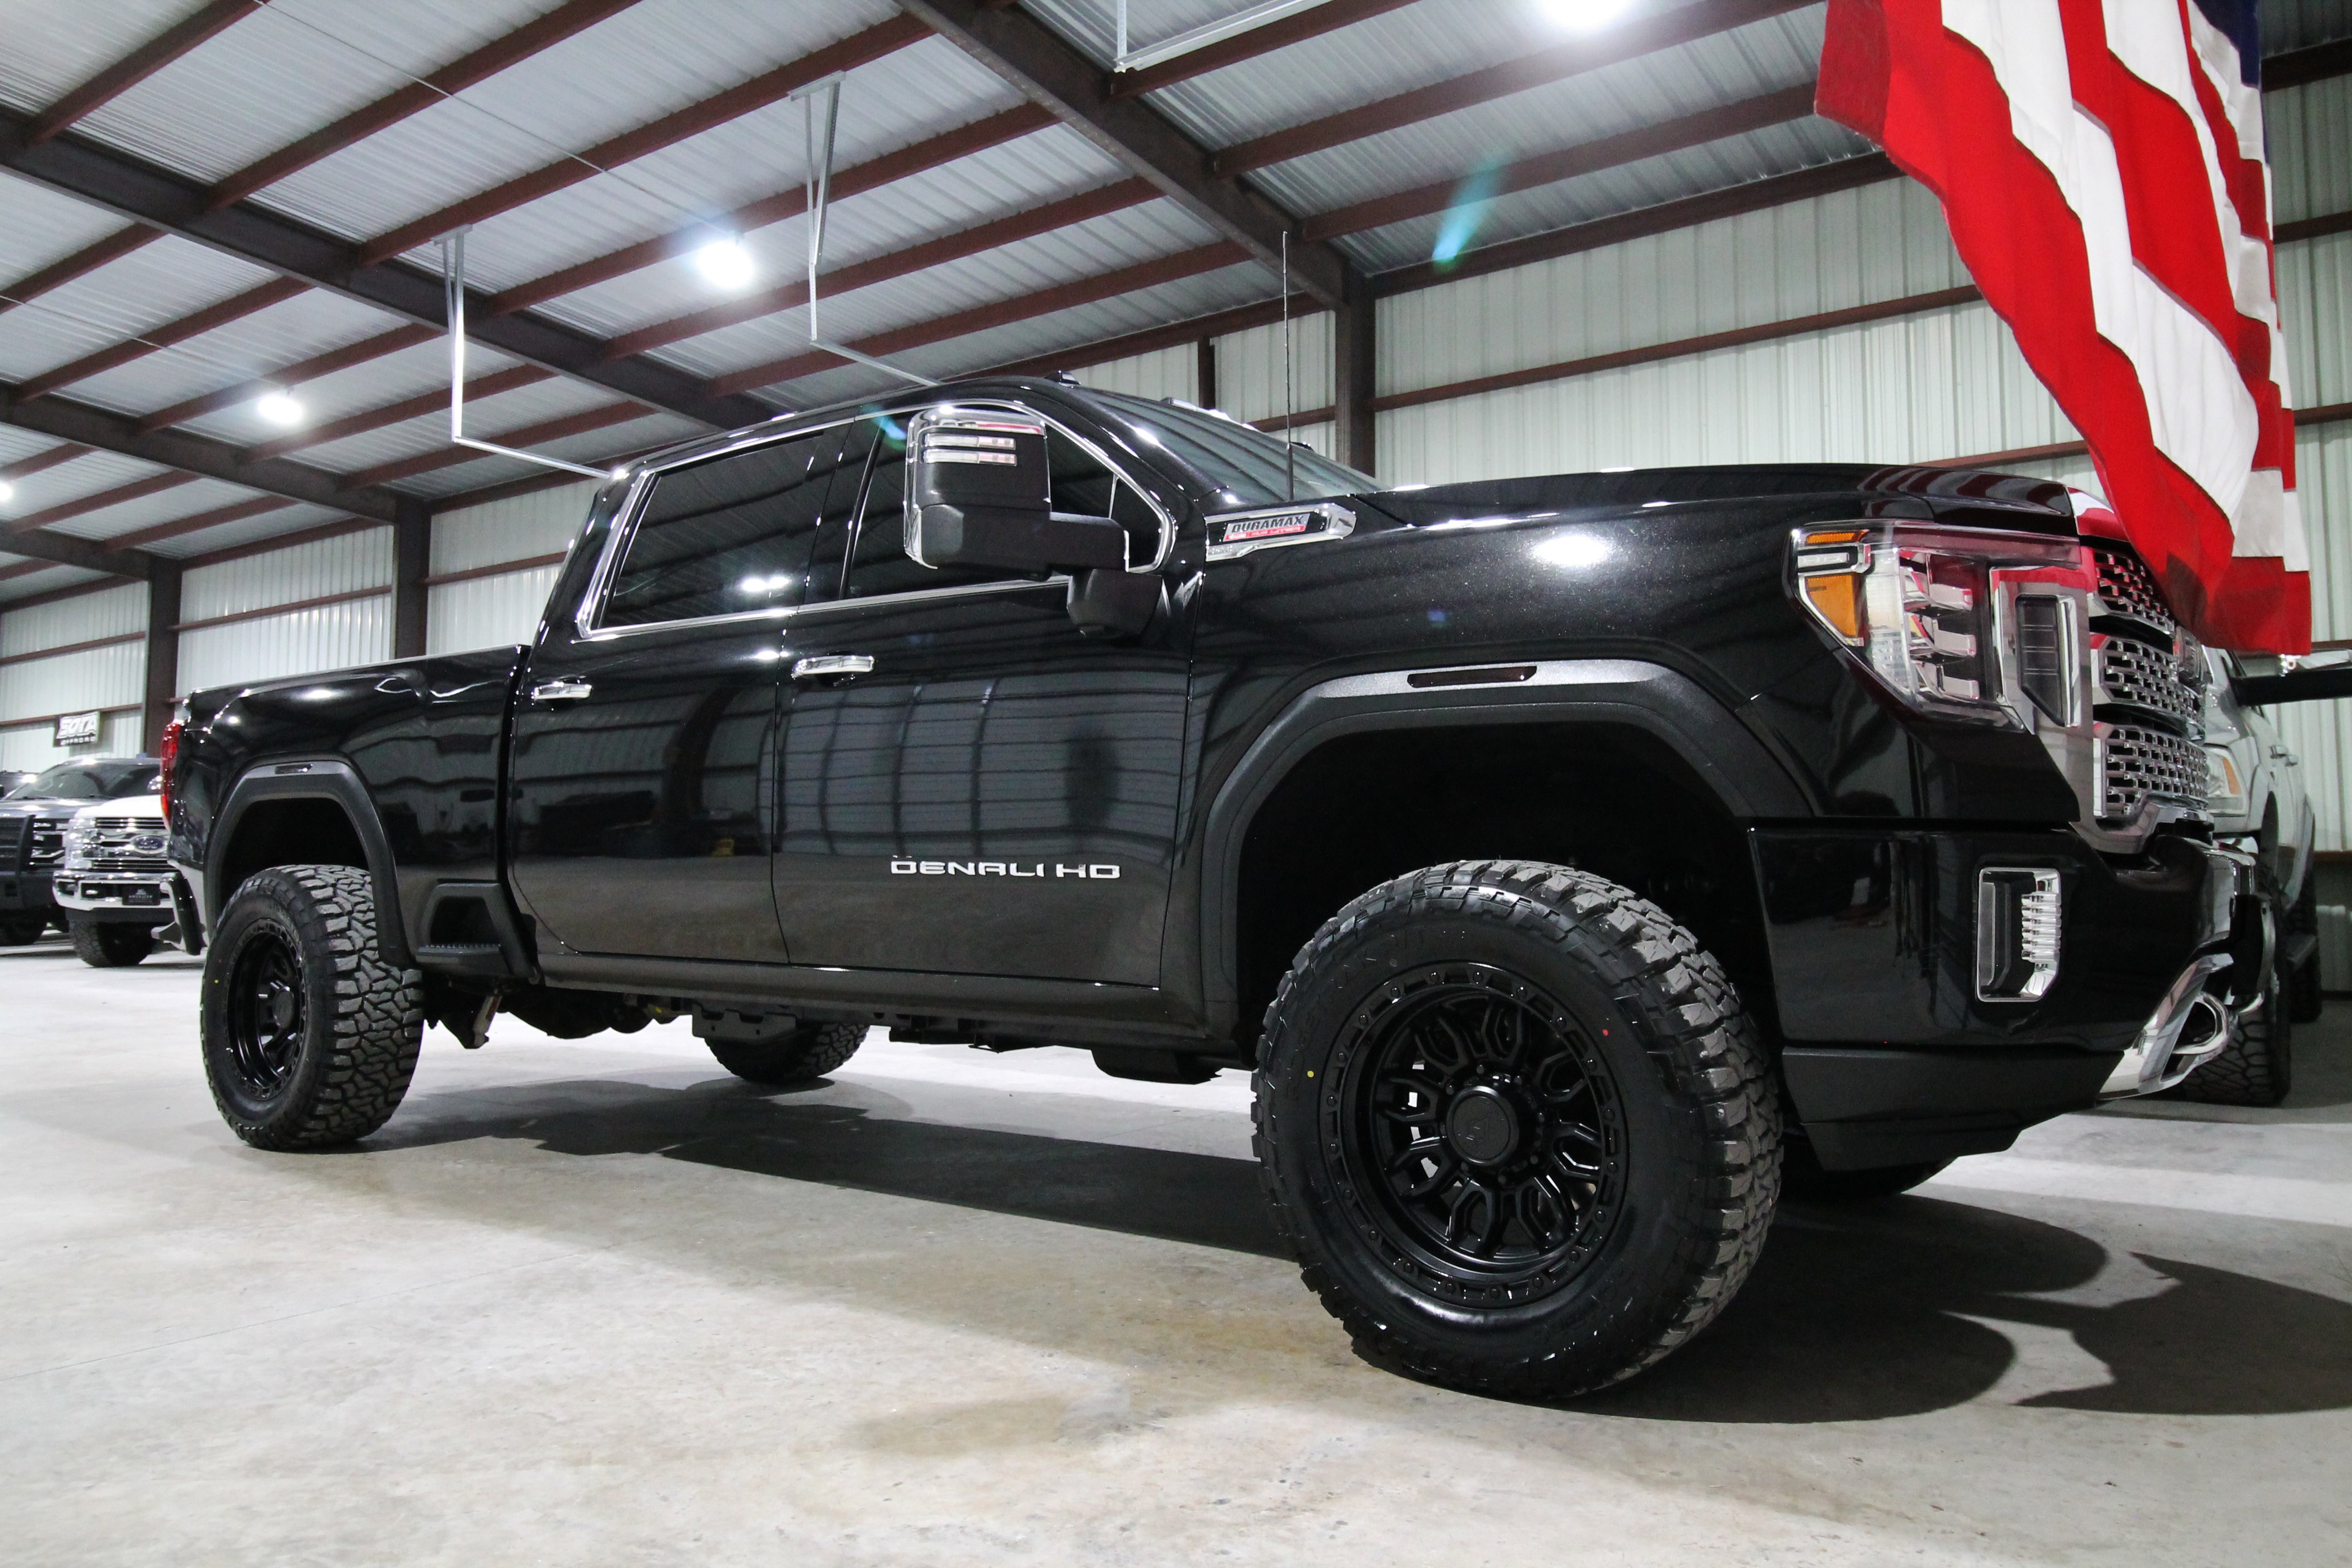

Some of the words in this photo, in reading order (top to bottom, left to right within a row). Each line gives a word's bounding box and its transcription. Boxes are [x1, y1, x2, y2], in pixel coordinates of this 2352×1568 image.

[1231, 516, 1303, 533] DURAMAX
[56, 712, 98, 738] SOTA
[890, 861, 1044, 877] DENALI
[1055, 864, 1120, 879] HD
